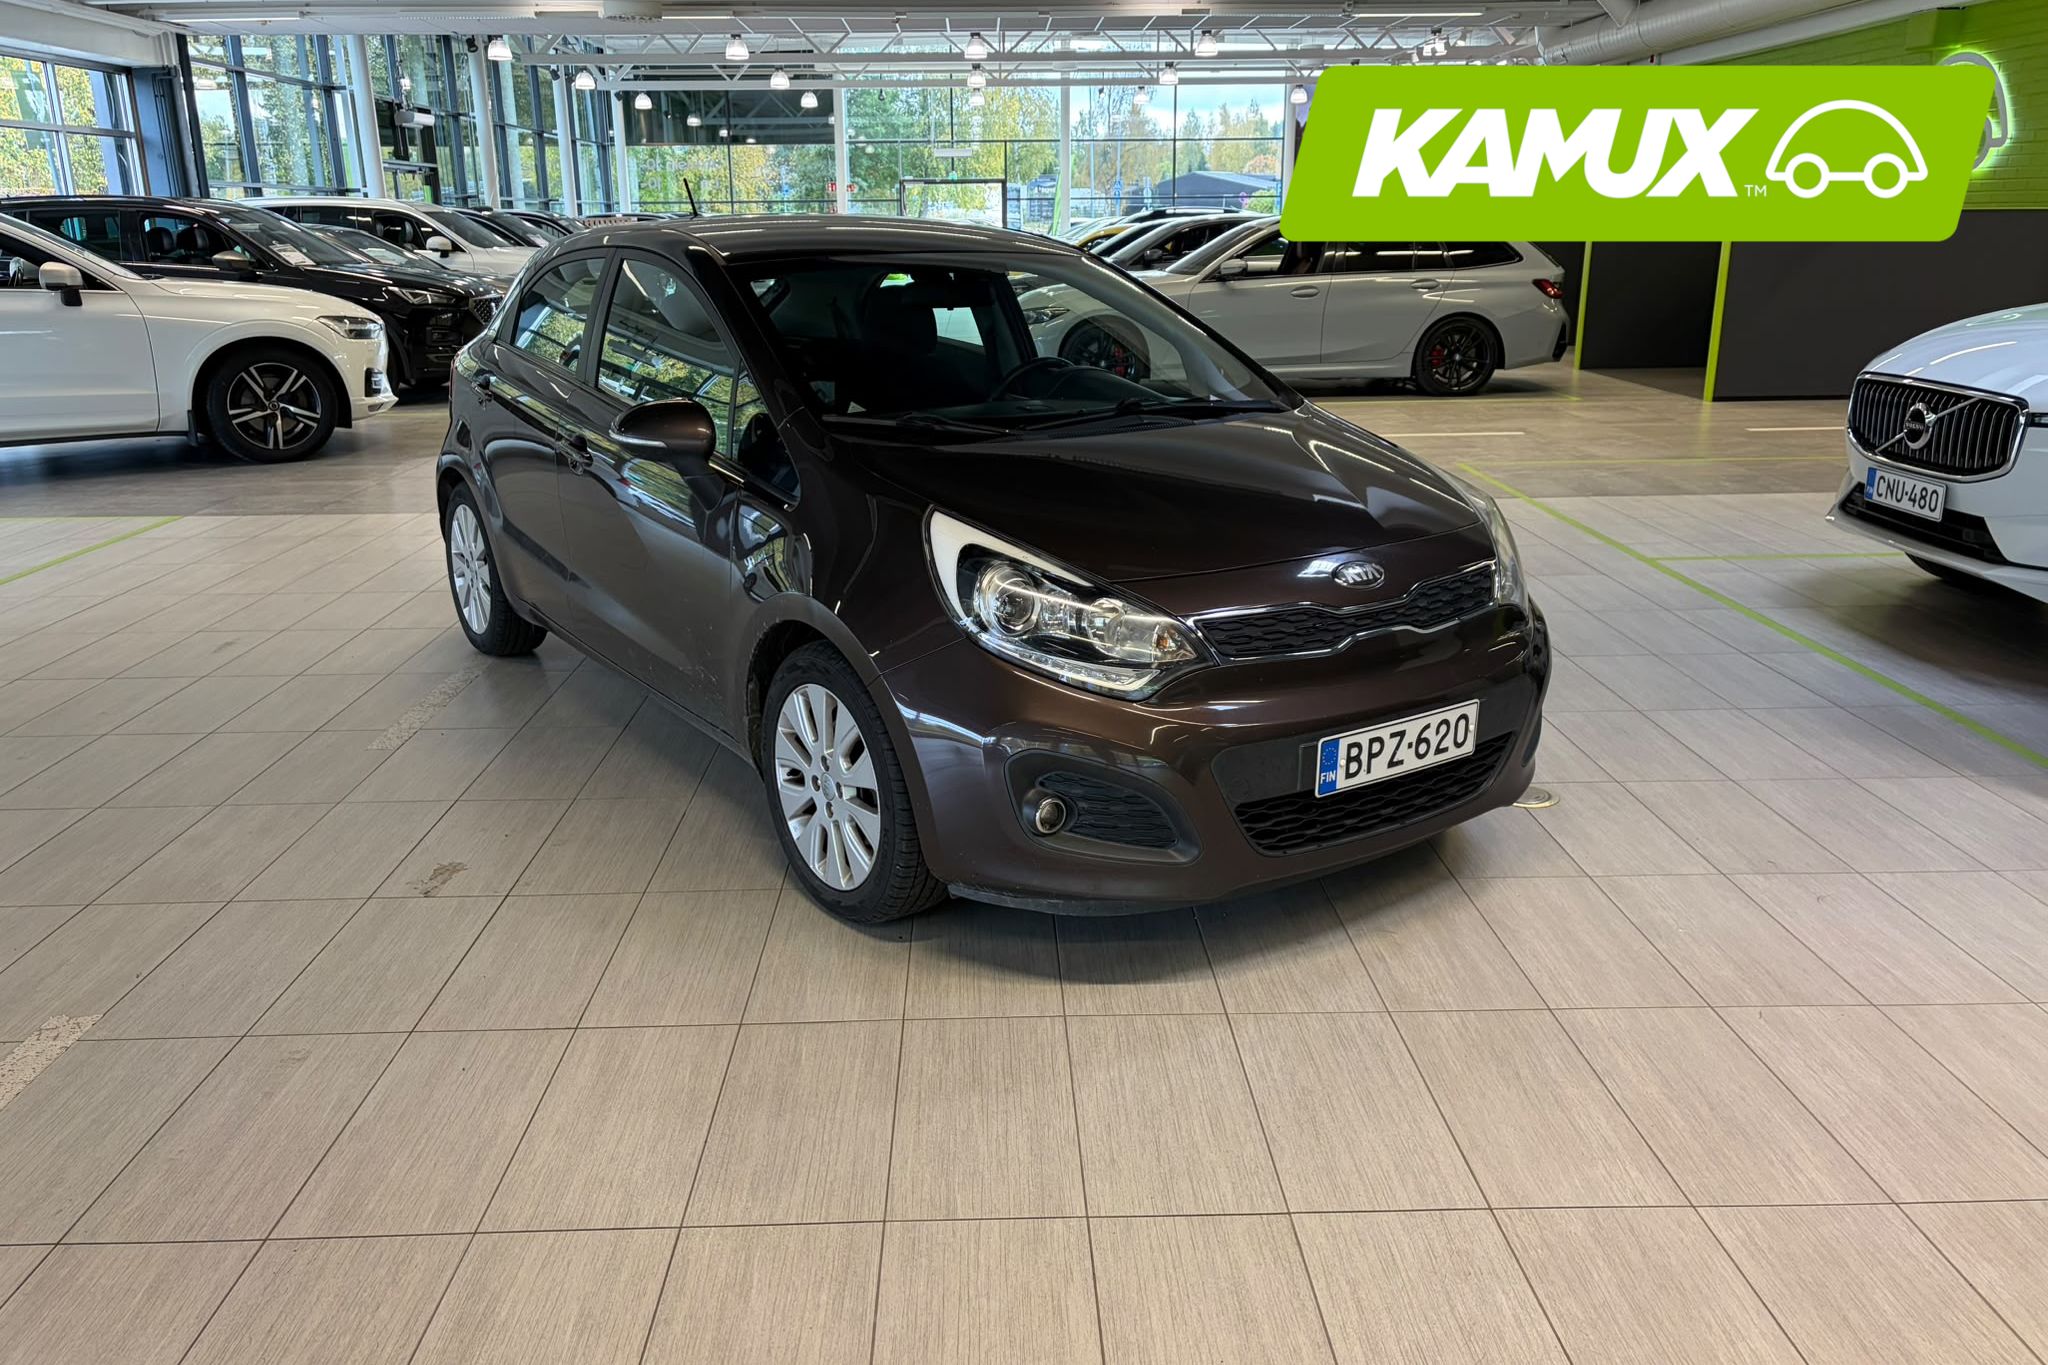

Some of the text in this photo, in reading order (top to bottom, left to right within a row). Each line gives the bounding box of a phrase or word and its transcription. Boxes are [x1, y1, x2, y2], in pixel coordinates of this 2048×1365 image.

[1876, 475, 1939, 513] CNU-480
[1341, 563, 1381, 584] KIA
[1344, 713, 1470, 780] BPZ-620
[1319, 770, 1337, 785] FIN
